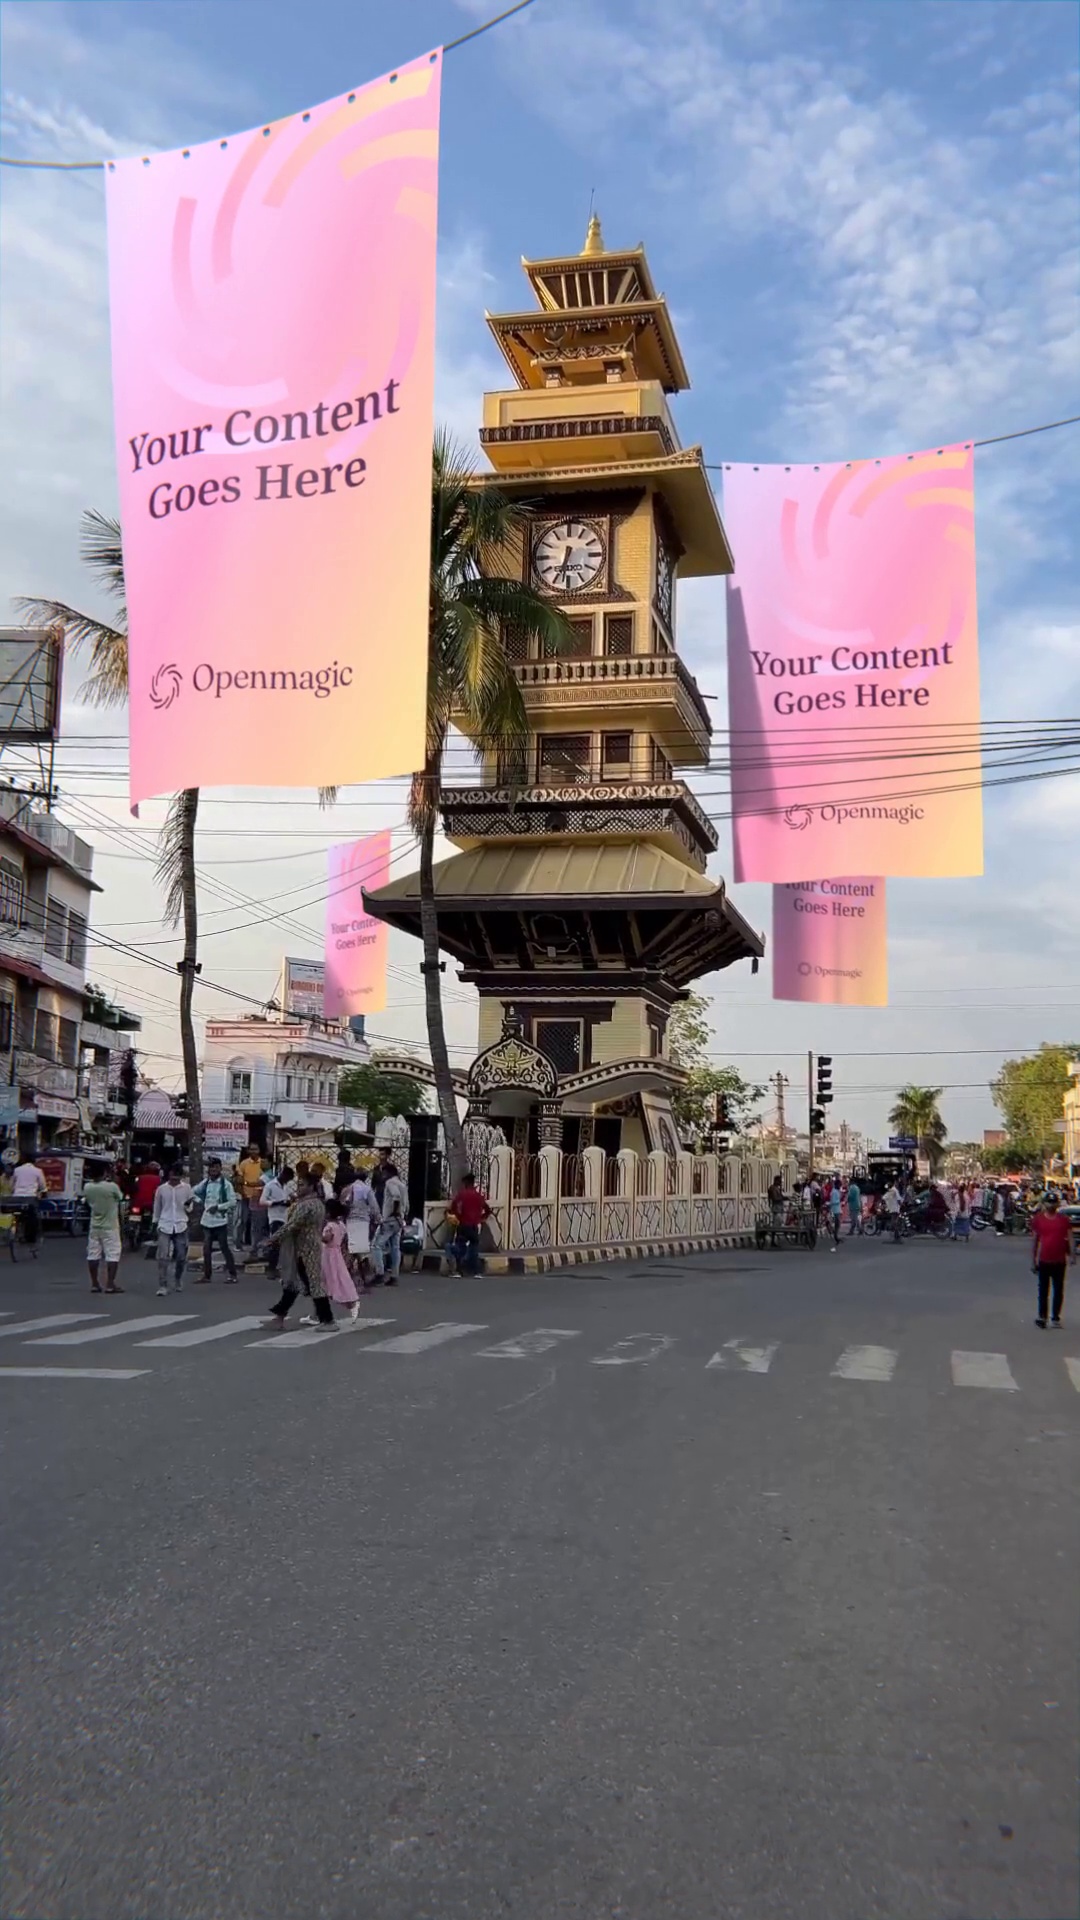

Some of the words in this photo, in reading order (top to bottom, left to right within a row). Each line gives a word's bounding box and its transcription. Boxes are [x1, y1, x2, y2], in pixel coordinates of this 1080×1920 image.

[129, 424, 212, 473] Your
[224, 378, 400, 446] Content
[148, 474, 241, 519] Goes
[255, 456, 366, 500] Here
[554, 564, 582, 572] SIKO
[750, 650, 822, 678] Your
[831, 641, 953, 671] Content
[193, 661, 353, 698] Openmagic
[773, 689, 846, 715] Goes
[854, 683, 929, 708] Here
[820, 804, 925, 825] Openmagic
[820, 879, 875, 897] Content
[793, 897, 828, 915] Goes
[832, 901, 865, 918] Here
[331, 923, 350, 934] Your
[335, 938, 356, 950] Goes
[357, 934, 377, 947] Here
[815, 966, 863, 979] Openmagic
